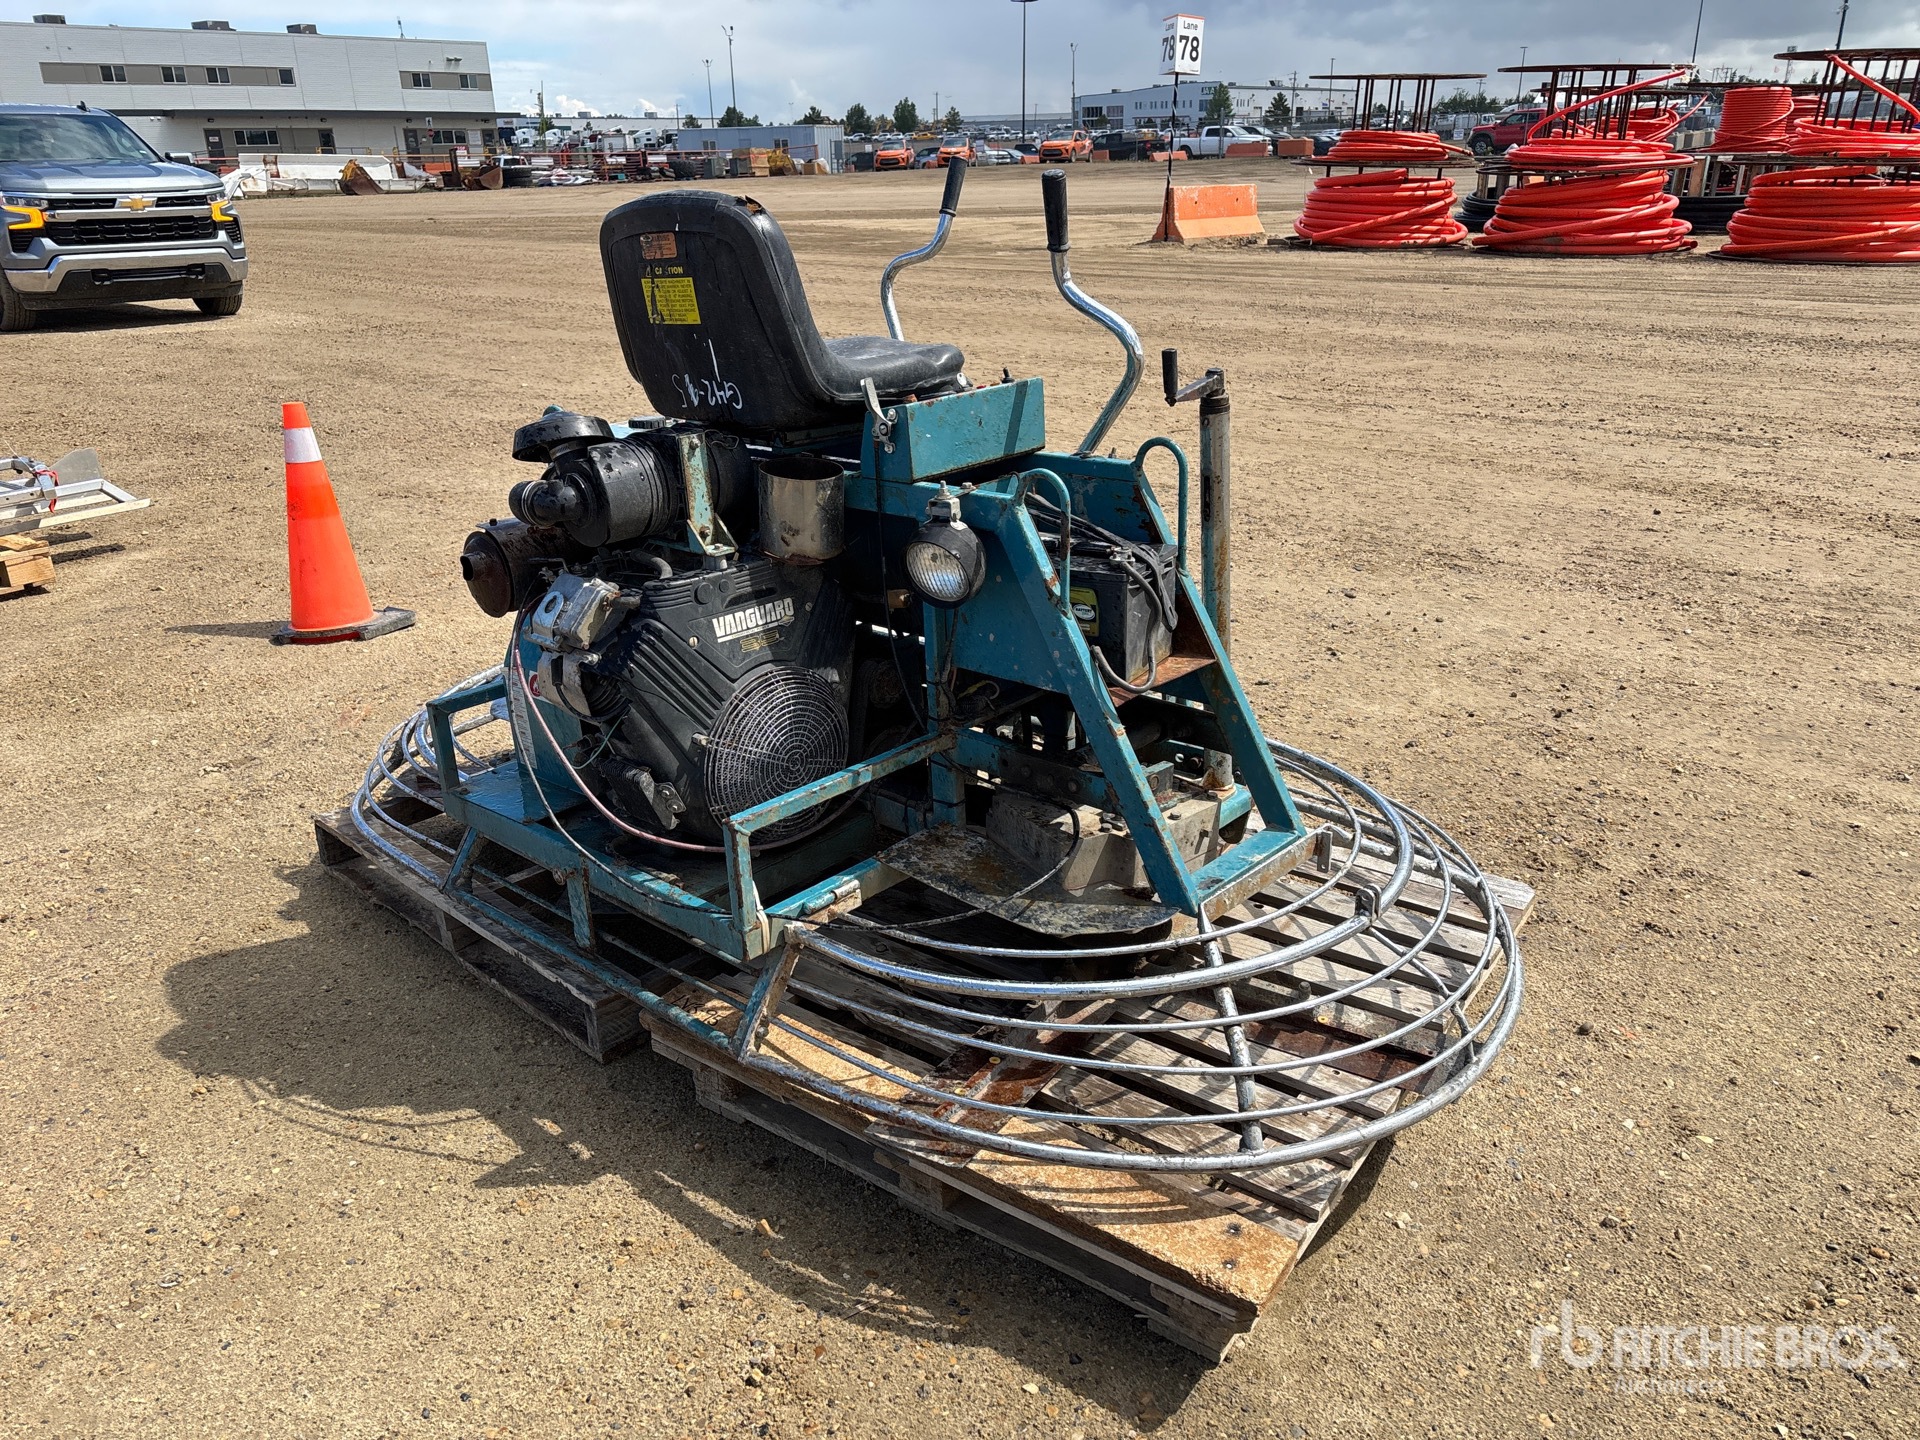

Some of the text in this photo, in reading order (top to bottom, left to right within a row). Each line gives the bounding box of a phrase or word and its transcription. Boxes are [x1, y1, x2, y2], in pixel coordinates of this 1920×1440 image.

[1183, 20, 1199, 31] Lane
[1162, 34, 1175, 62] 78
[1179, 35, 1200, 62] 78
[711, 597, 795, 638] VANGUARD
